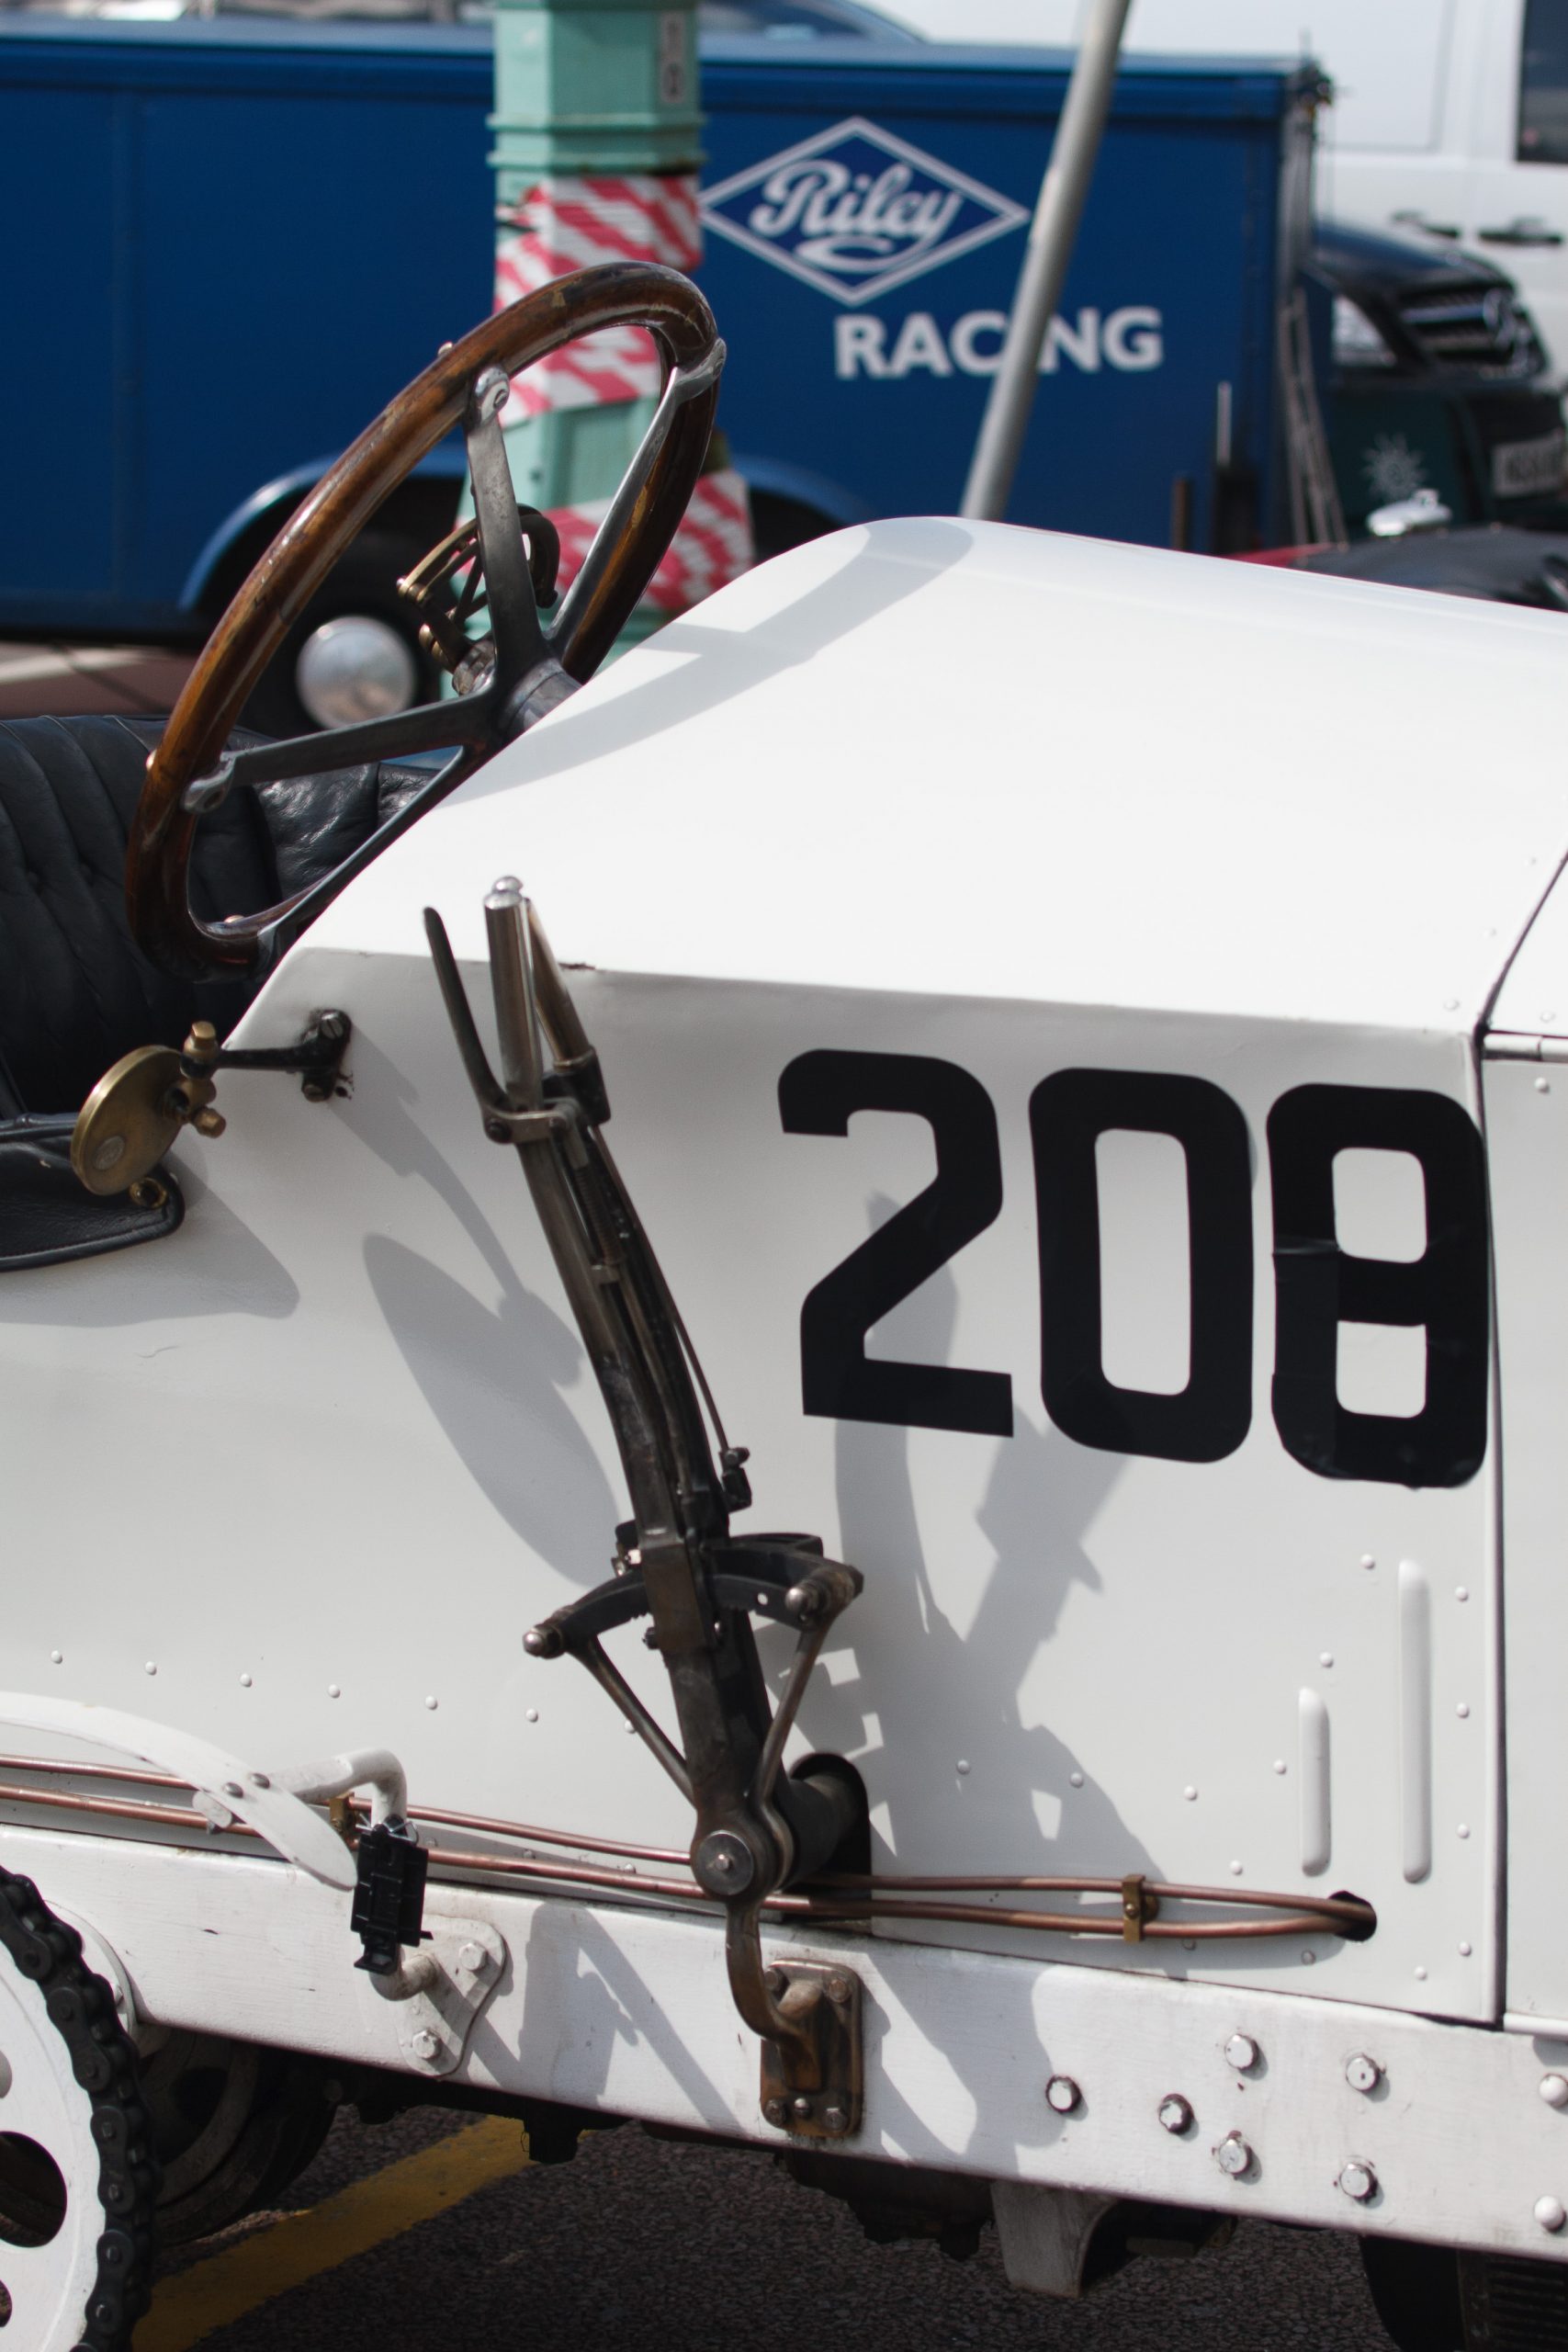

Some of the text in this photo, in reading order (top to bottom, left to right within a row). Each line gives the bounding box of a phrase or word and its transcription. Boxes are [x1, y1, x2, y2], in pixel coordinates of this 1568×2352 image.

[750, 159, 964, 273] Riley
[834, 307, 1164, 379] RACNG
[778, 1049, 1488, 1489] 208
